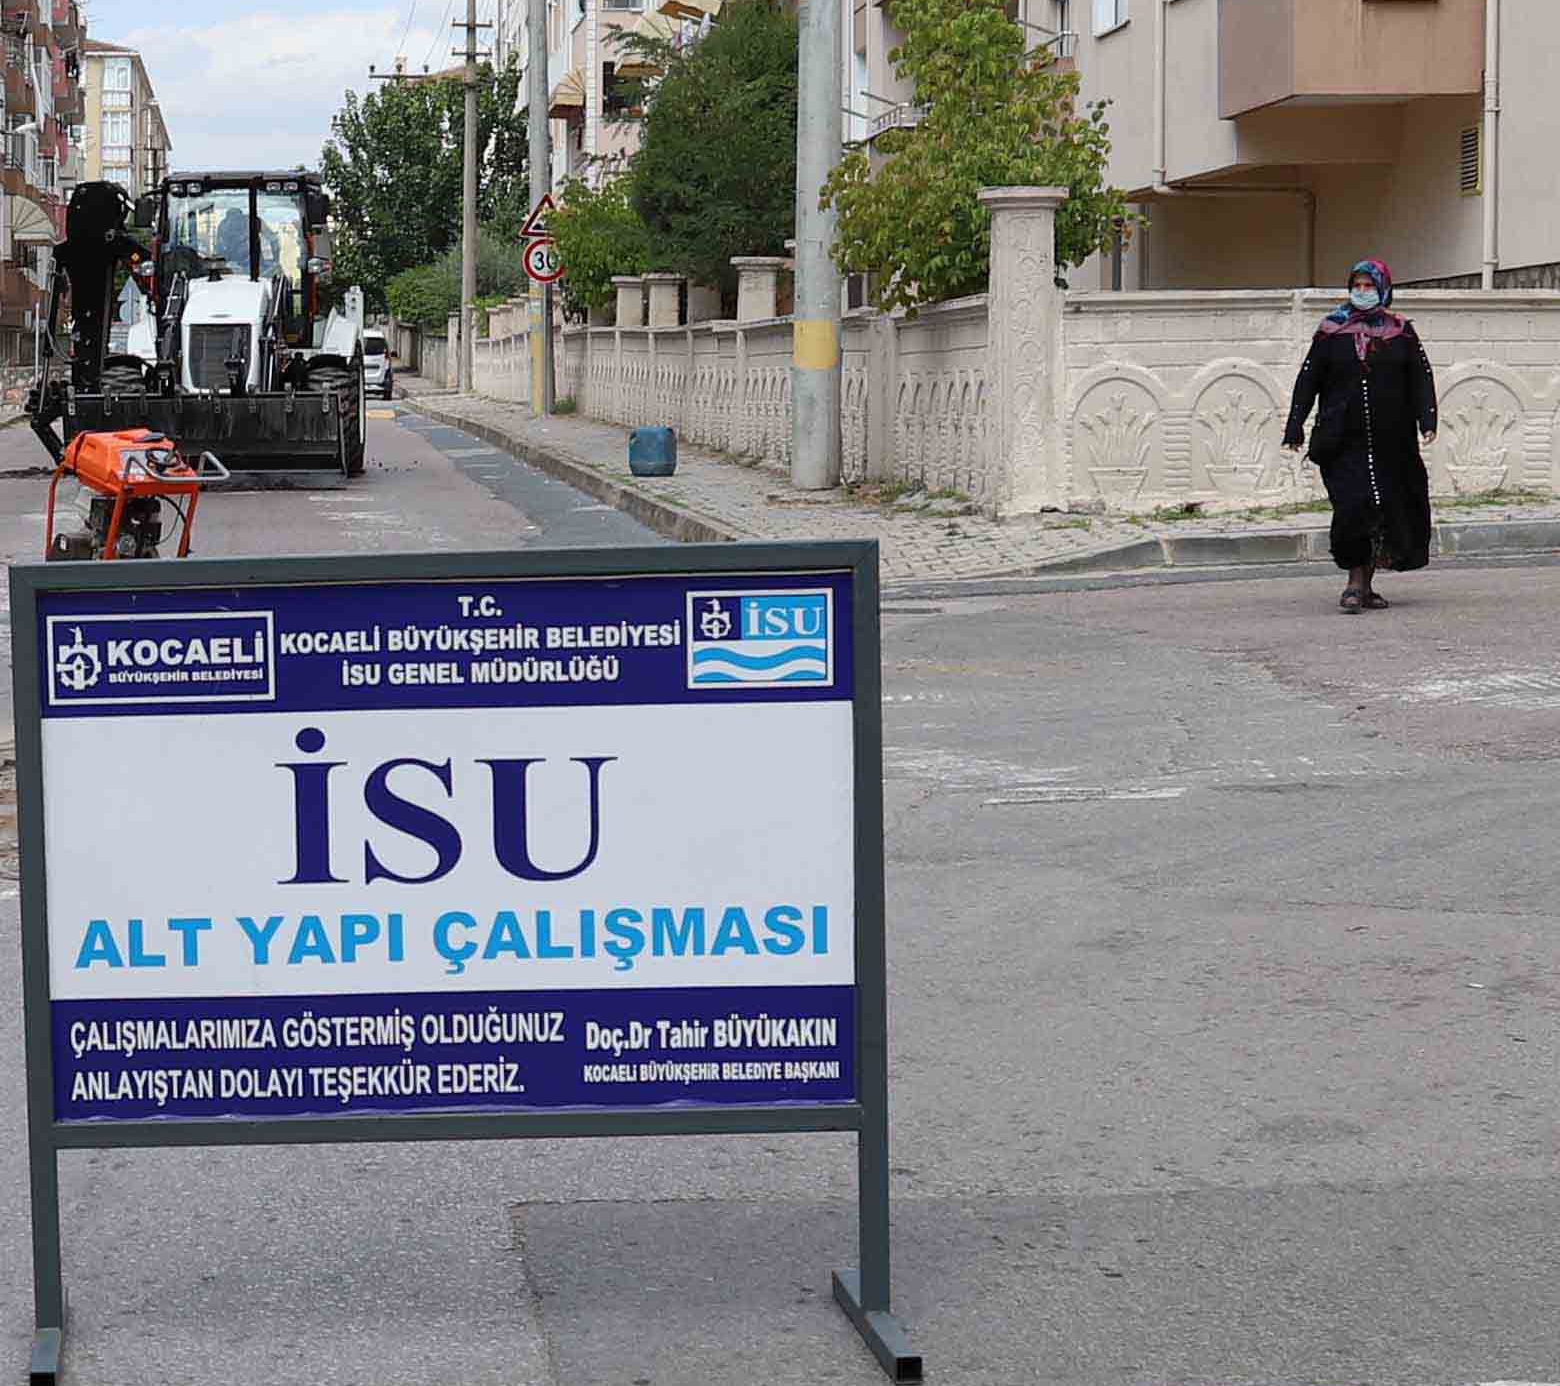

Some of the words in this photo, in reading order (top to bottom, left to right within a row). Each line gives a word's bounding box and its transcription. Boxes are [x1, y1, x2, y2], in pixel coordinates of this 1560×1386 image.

[457, 595, 502, 617] T.C.
[747, 601, 826, 636] İSU
[107, 630, 265, 666] KOCAELİ
[280, 625, 381, 655] KOCAELİ
[388, 623, 541, 656] BÜYÜKŞEHİR
[545, 619, 681, 650] BELEDİYESİ
[108, 670, 189, 685] BÜYÜKŞEHİR
[191, 668, 264, 682] BELEDİYESİ
[342, 659, 381, 686] İSU
[387, 661, 465, 685] GENEL
[471, 655, 619, 684] MÜDÜRLÜĞÜ
[274, 727, 619, 886] İSU
[74, 917, 213, 969] ALT
[235, 912, 405, 966] YAPI
[432, 904, 830, 975] ÇALIŞMASI
[70, 1018, 277, 1059] ÇALIŞMALARIMIZA
[282, 1008, 416, 1052] GÖSTERMİŞ
[421, 1006, 565, 1044] OLDUĞUNUZ
[586, 1021, 653, 1057] Doç.Dr
[656, 1020, 709, 1049] Tahir
[712, 1013, 836, 1048] BÜYÜKAKIN
[71, 1069, 214, 1106] ANLAYIŞTAN
[220, 1067, 304, 1099] DOLAYI
[308, 1059, 432, 1104] TEŞEKKÜR
[437, 1056, 525, 1095] EDERİZ.
[783, 1061, 840, 1083] BAŞKANI
